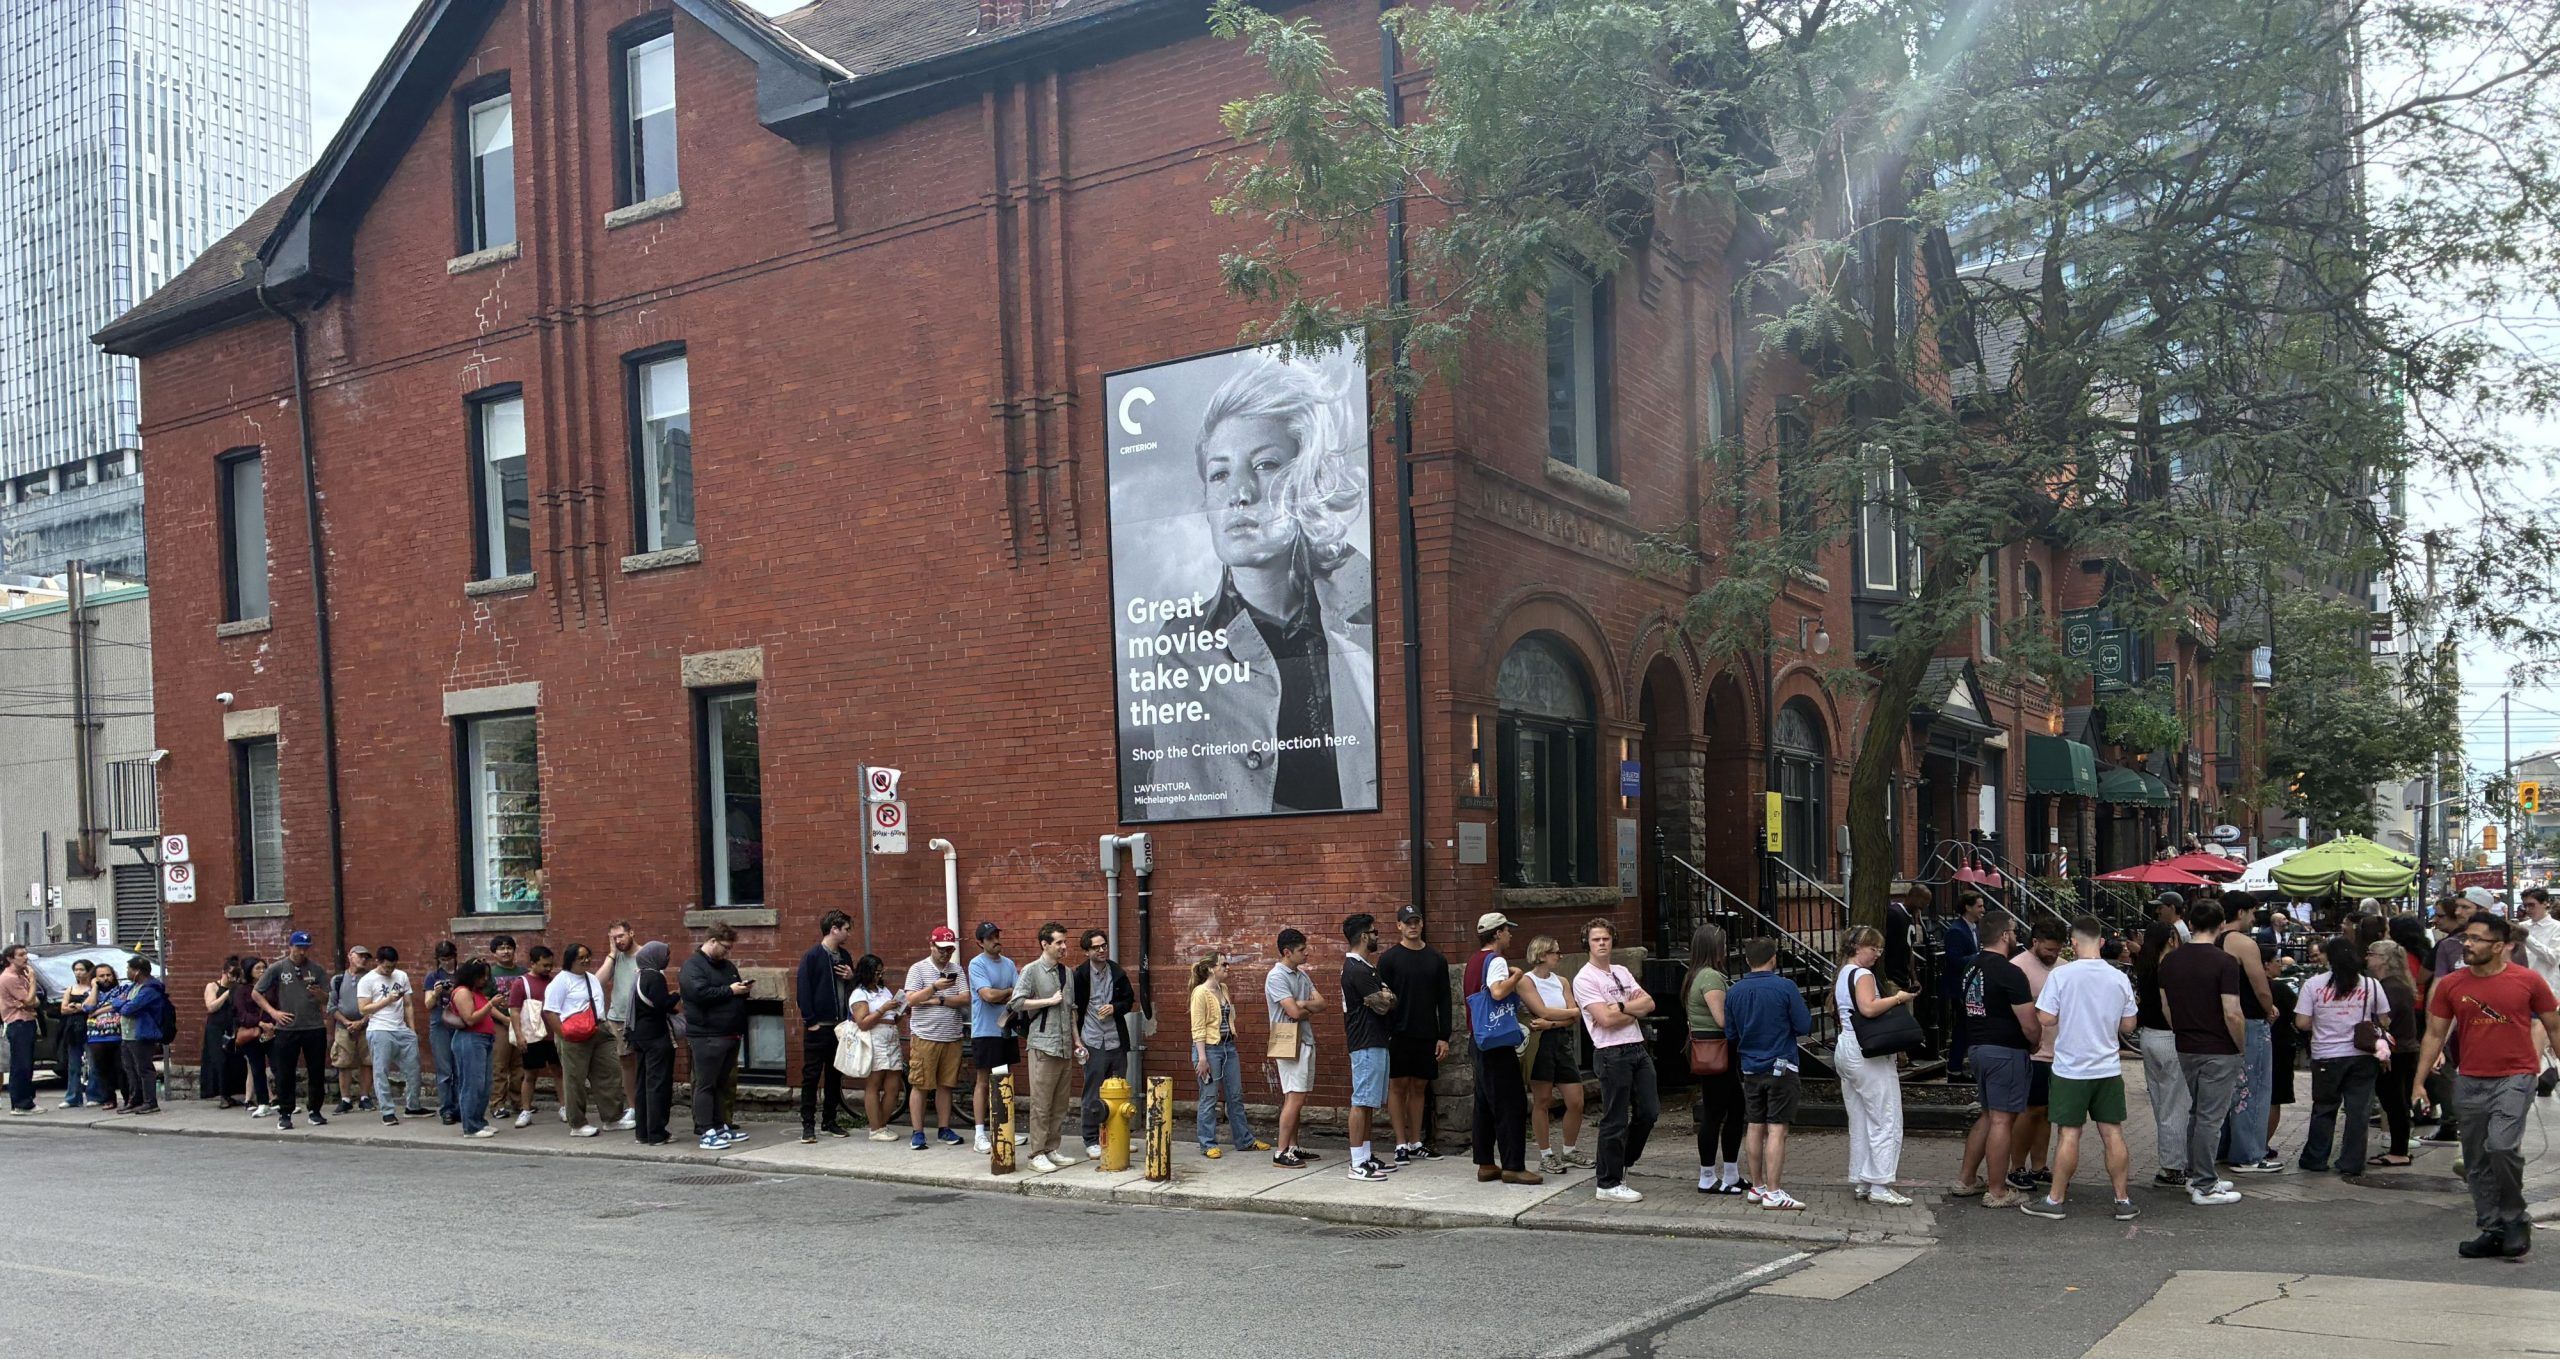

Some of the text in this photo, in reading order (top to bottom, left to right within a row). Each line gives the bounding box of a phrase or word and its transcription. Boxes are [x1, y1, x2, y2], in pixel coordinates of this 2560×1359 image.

[1120, 441, 1158, 455] CRITERION
[1127, 591, 1204, 624] Great
[1128, 625, 1229, 658] movies
[1129, 661, 1250, 693] take you
[1130, 699, 1211, 726] there.
[1132, 734, 1360, 762] Shop the Criterion Collection here.
[1133, 781, 1191, 794] L'AVVENTURA
[1134, 791, 1228, 805] Michelangelo Antonioni
[1144, 842, 1152, 864] OUC
